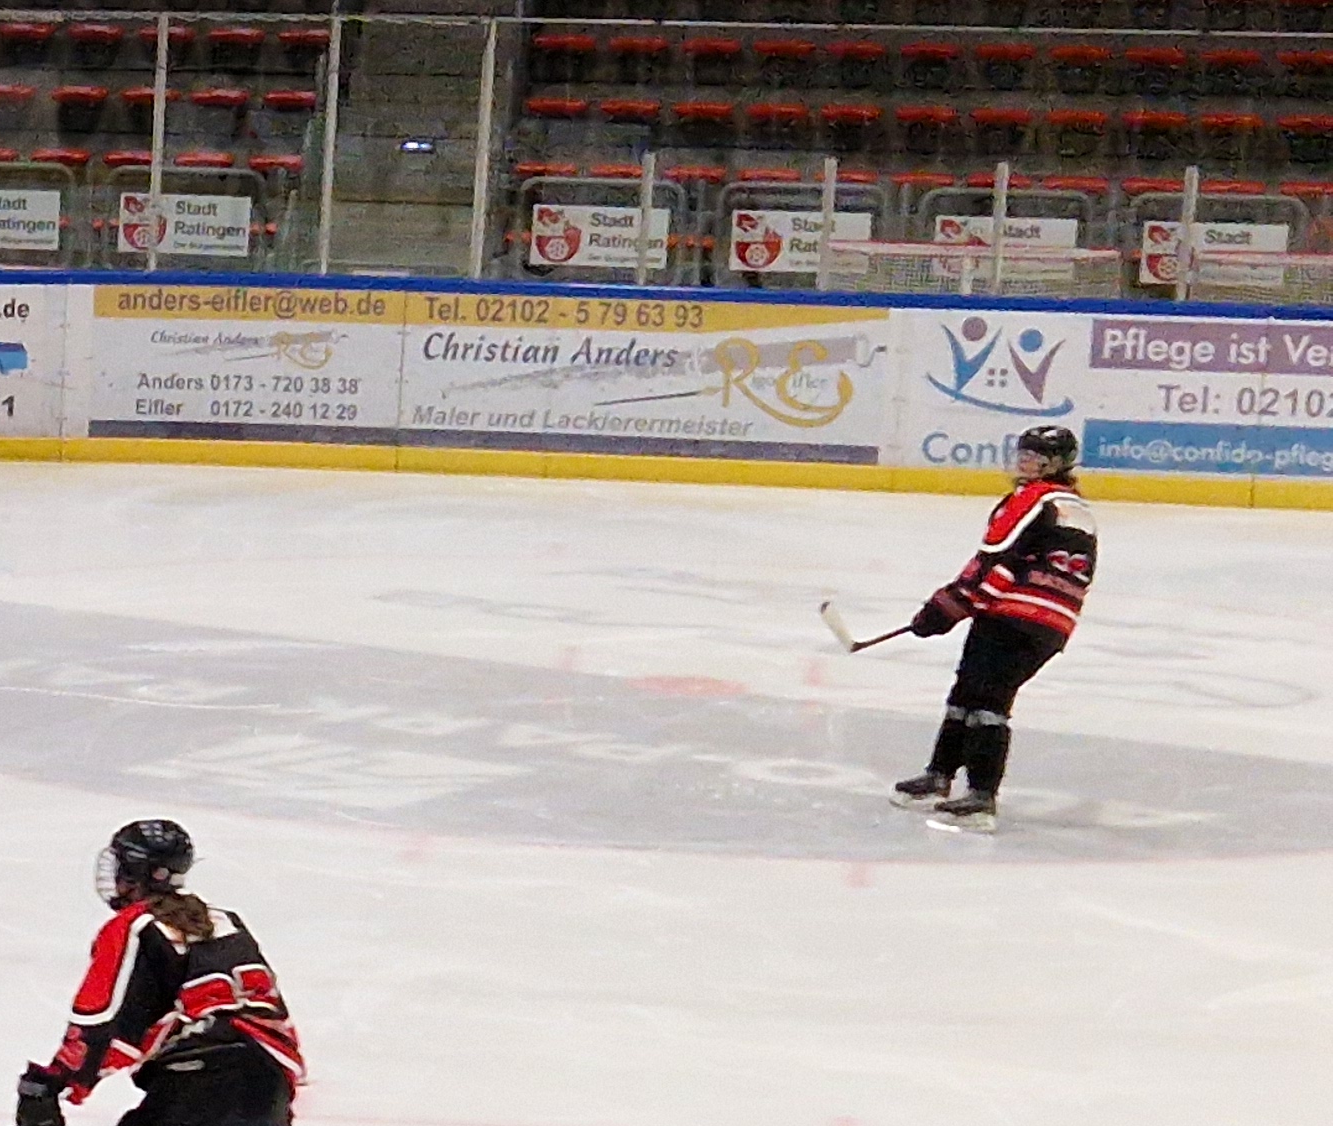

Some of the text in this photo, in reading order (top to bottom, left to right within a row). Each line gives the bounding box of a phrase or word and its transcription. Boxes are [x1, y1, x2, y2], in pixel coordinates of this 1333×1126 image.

[174, 201, 218, 217] Stadt
[173, 219, 247, 240] Ratingen
[117, 289, 387, 319] anders-eifler@web.de
[425, 296, 465, 322] Tel.
[475, 298, 550, 324] 02102
[576, 301, 589, 324] 5
[597, 301, 627, 326] 79
[636, 302, 667, 328] 63
[674, 303, 704, 328] 93
[422, 331, 559, 364] Christian
[571, 338, 679, 369] Anders
[1100, 327, 1215, 368] Pflege
[1229, 332, 1271, 365] ist
[136, 373, 204, 392] Anders
[210, 373, 254, 393] 0173
[272, 375, 304, 395] 720
[309, 376, 331, 395] 38
[337, 376, 360, 396] 38
[1157, 384, 1222, 416] Tel:
[135, 398, 183, 416] Eifler
[210, 399, 253, 418] 0172
[271, 401, 303, 419] 240
[308, 402, 329, 420] 12
[411, 404, 755, 438] Maler und Lackierermeister
